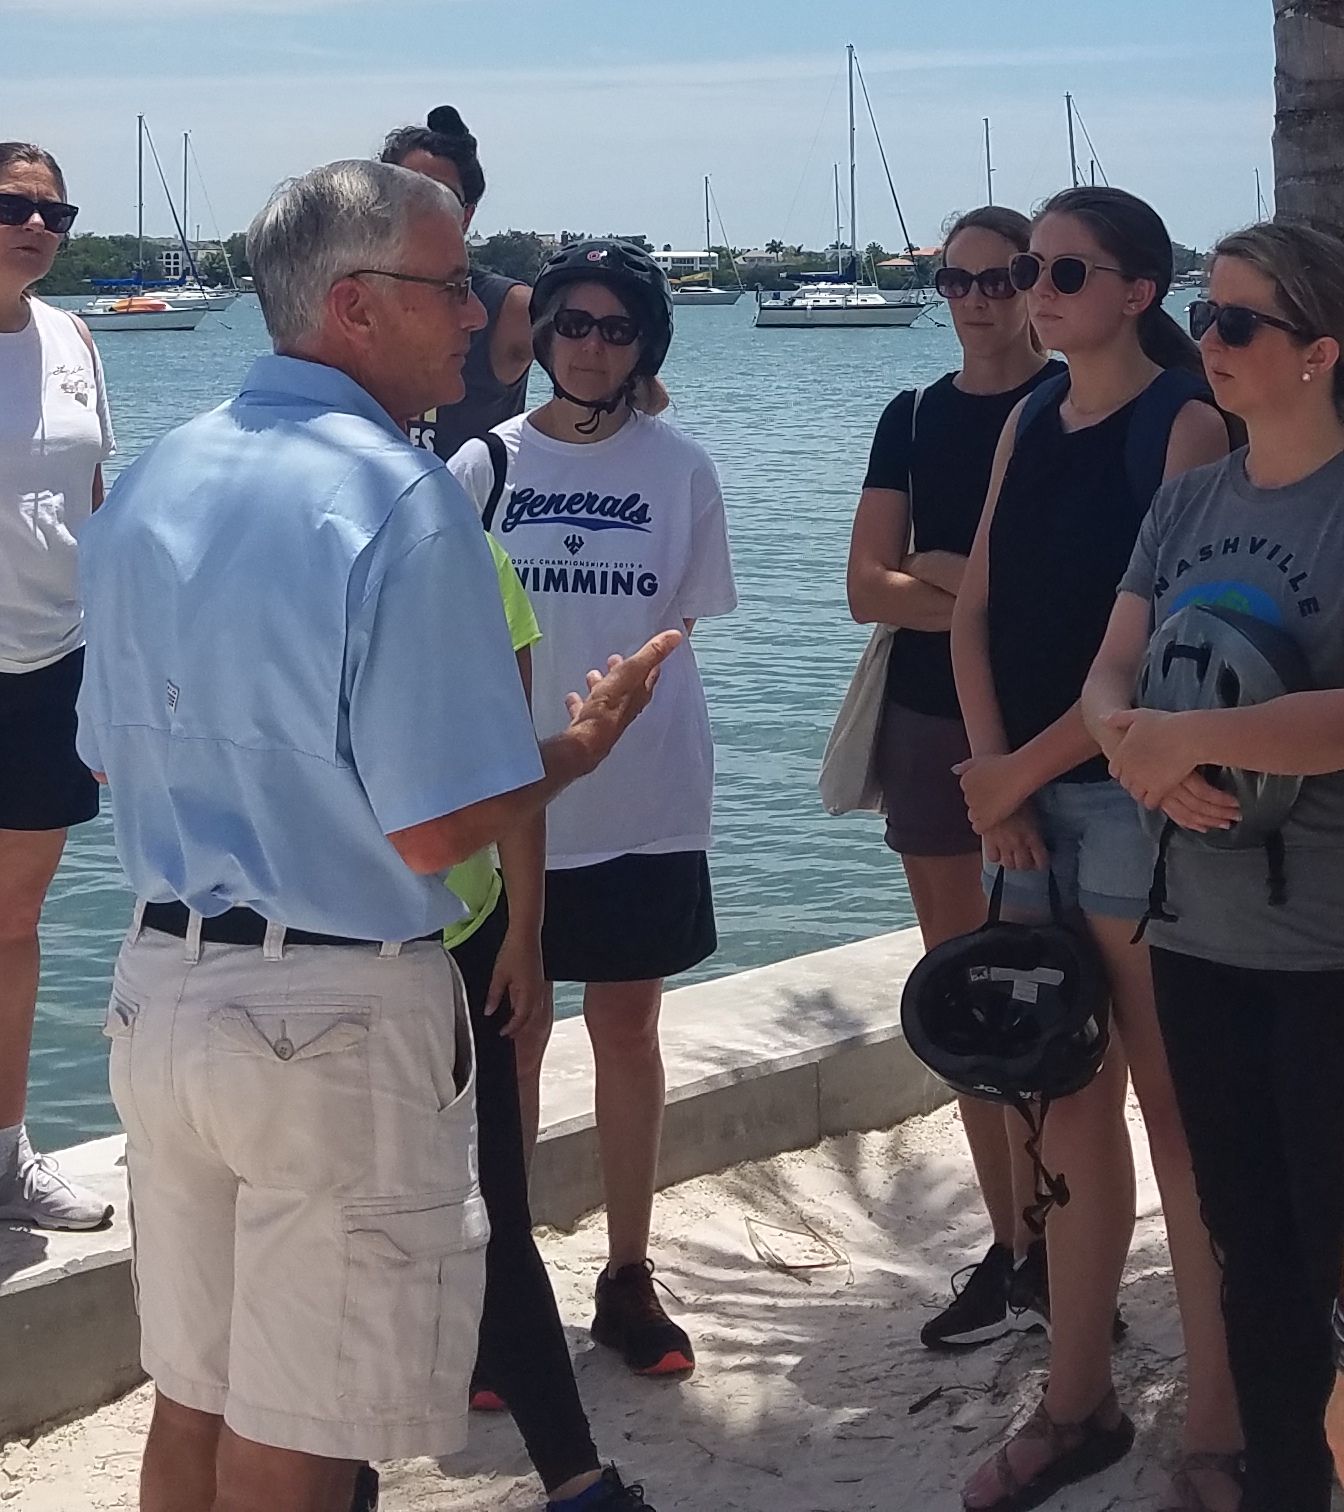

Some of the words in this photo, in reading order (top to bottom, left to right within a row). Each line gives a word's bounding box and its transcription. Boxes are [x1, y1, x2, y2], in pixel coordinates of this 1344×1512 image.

[502, 488, 653, 532] Generals
[539, 558, 609, 568] CHAMPIONSHIPS
[1154, 536, 1321, 618] NASHVILLE
[514, 567, 659, 597] IMMING
